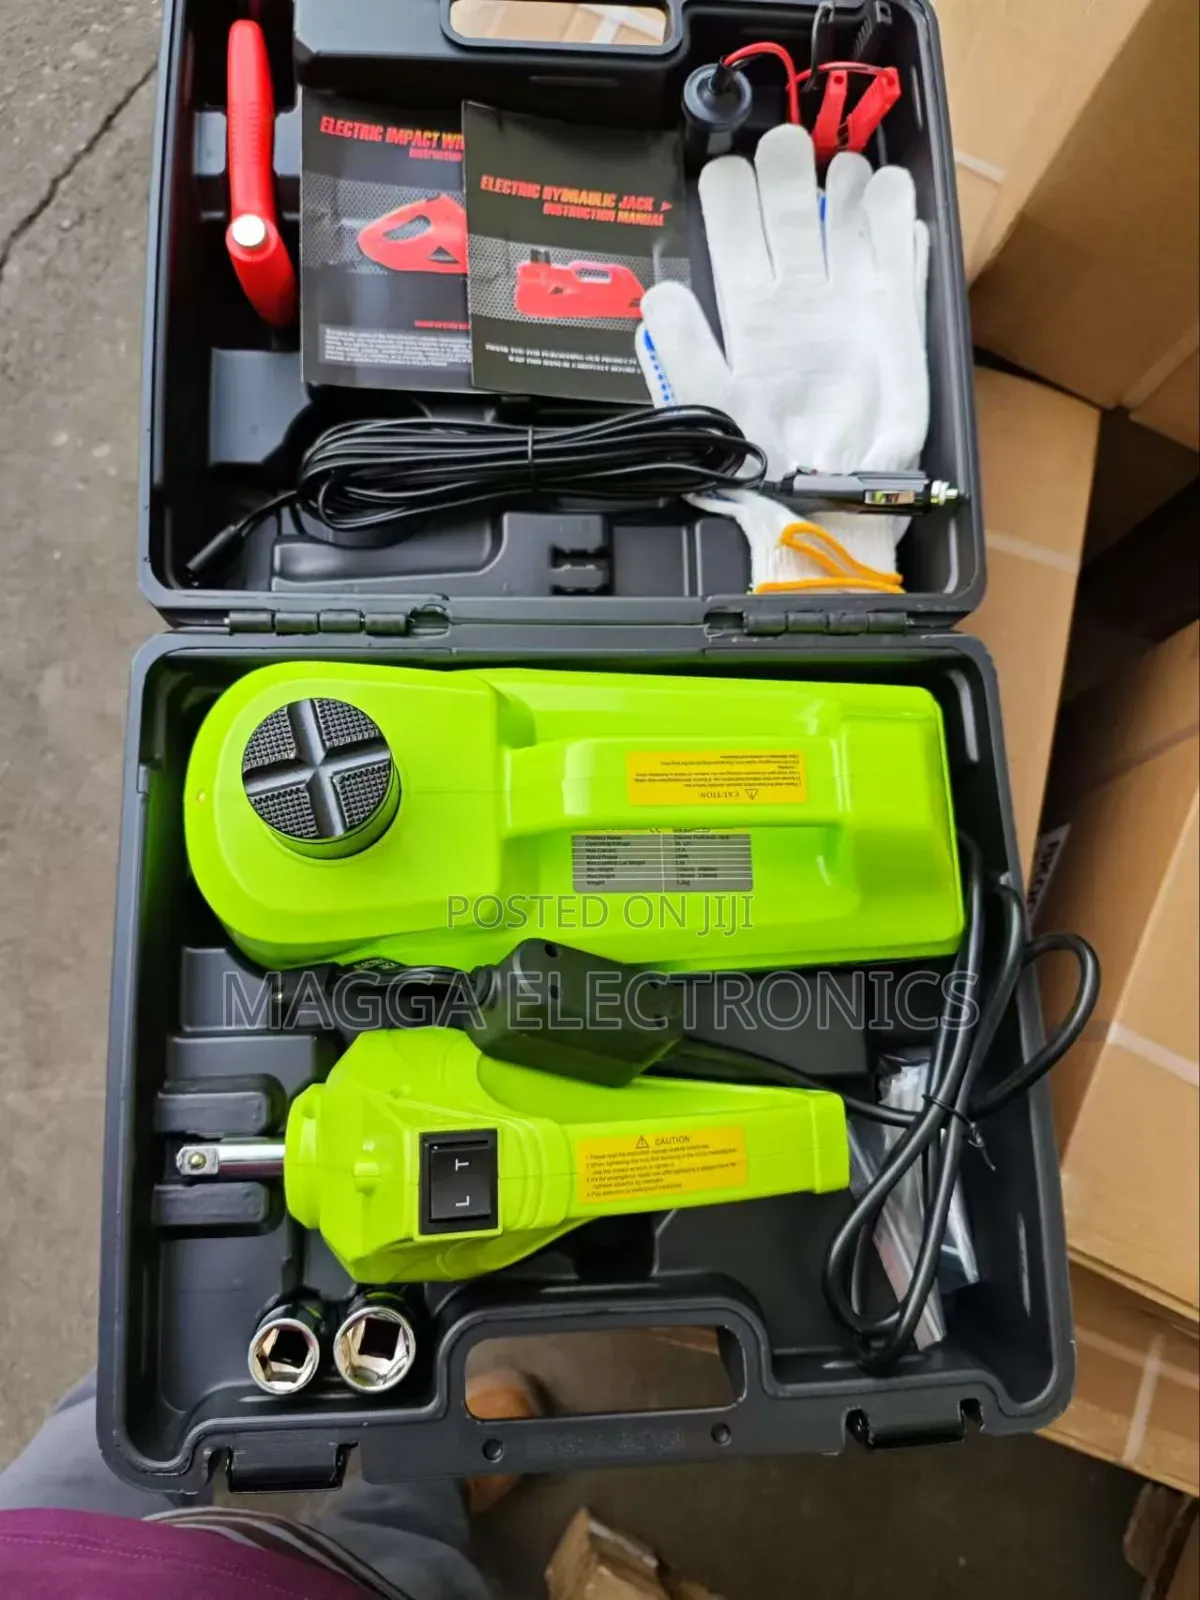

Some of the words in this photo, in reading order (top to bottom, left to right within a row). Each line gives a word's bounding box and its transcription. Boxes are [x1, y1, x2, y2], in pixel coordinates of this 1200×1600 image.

[320, 116, 384, 142] ELECTRIC
[386, 126, 440, 149] IMPACT
[480, 174, 541, 199] ELECTRIC
[542, 185, 617, 208] HYDRAULIC
[618, 195, 655, 211] JACK
[543, 202, 616, 222] INSTRUCTION
[617, 210, 665, 227] MANUAL
[655, 1135, 690, 1146] CAUTION
[455, 1158, 470, 1172] T
[455, 1195, 470, 1207] L
